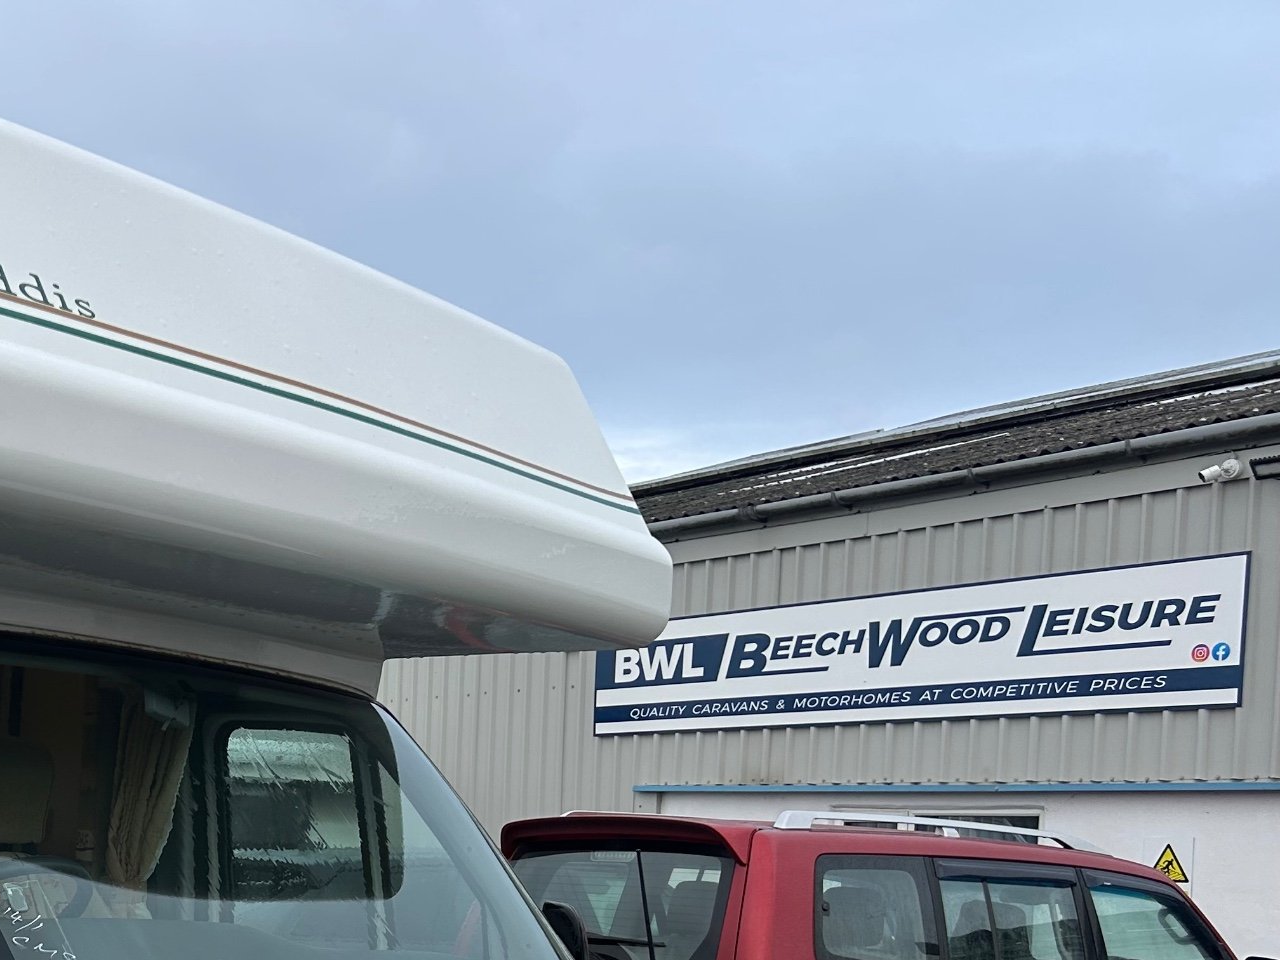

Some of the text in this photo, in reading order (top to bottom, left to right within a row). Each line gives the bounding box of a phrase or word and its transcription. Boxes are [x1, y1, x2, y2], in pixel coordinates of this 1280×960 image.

[614, 642, 704, 684] BWL
[1016, 593, 1222, 657] LEISURE
[629, 675, 1168, 720] QUALITY CARAVANS & MOTORHOMES AT COMPETITIVE PRICES
